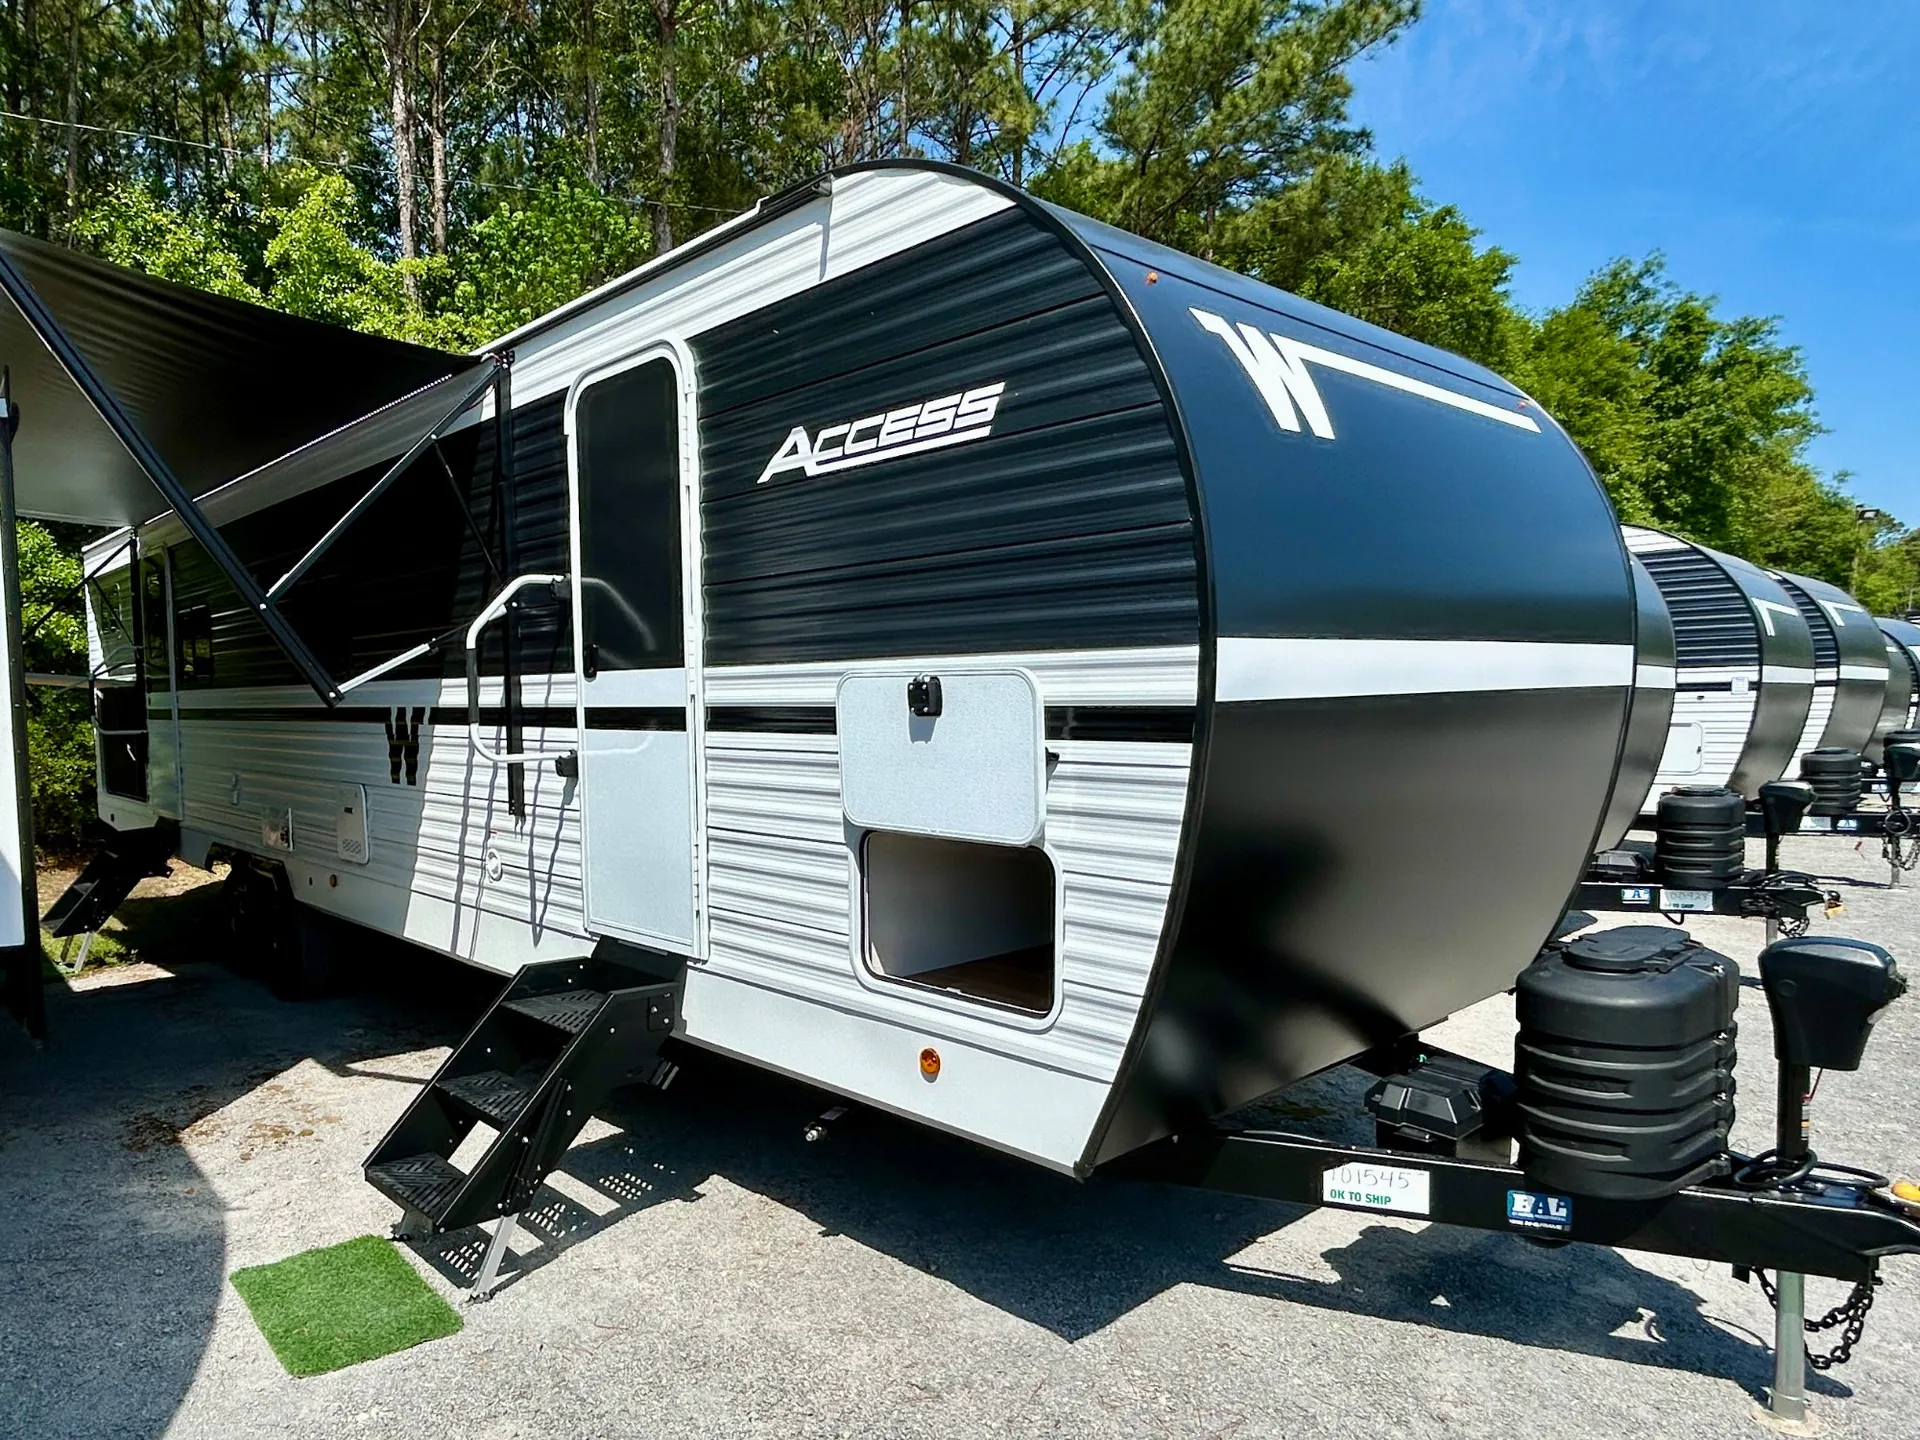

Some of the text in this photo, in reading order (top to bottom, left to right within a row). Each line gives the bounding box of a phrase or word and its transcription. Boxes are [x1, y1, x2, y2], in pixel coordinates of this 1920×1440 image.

[756, 381, 1006, 485] ACCESS
[1331, 1167, 1412, 1190] 101545
[1330, 1188, 1392, 1206] OK TO SHIP
